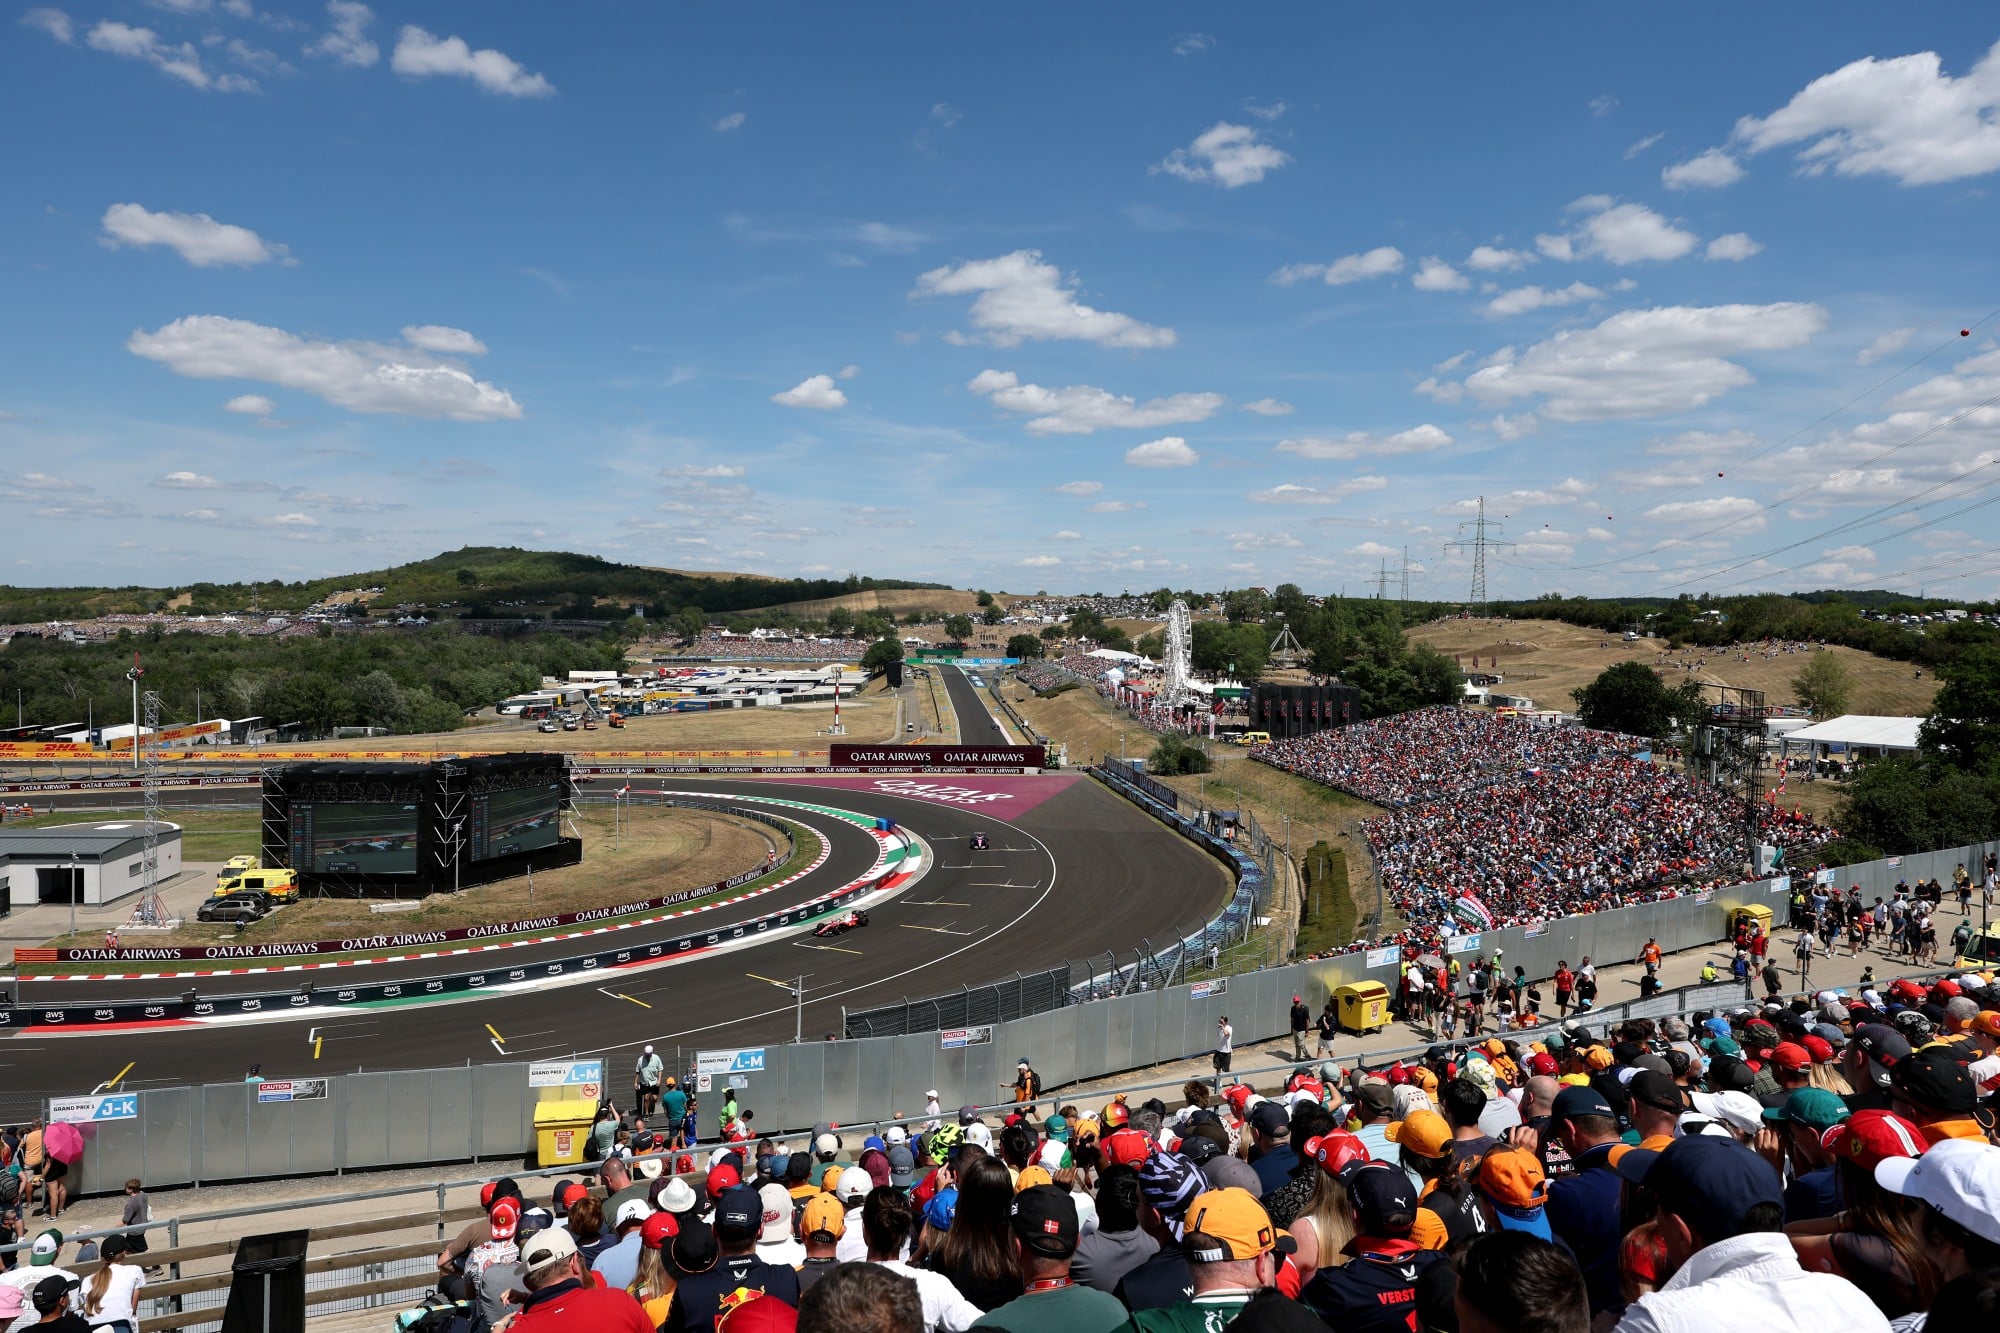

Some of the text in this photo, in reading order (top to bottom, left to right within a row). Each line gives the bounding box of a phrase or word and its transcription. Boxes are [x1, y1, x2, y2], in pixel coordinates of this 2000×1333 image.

[164, 730, 182, 740] DHL
[195, 724, 214, 734] DHL
[851, 752, 931, 761] QATAR AIRWAYS
[944, 753, 1024, 762] QATAR AIRWAYS
[874, 780, 1014, 800] QATAR
[726, 869, 762, 888] QATAR AIRWAYS
[662, 884, 717, 905] QATAR AIRWAYS
[576, 900, 649, 922] QATAR AIRWAYS
[1458, 909, 1478, 922] SINCE
[468, 916, 558, 938] QATAR AIRWAYS
[342, 931, 446, 950] QATAR AIRWAYS
[1467, 938, 1480, 948] A-B
[70, 949, 181, 960] QATAR AIRWAYS
[206, 943, 318, 958] QATAR AIRWAYS
[737, 1056, 762, 1068] L-M
[571, 1069, 598, 1080] L-M
[102, 1101, 135, 1116] J-K
[1549, 1164, 1569, 1173] Mobil
[1472, 1205, 1486, 1232] 4
[1377, 1288, 1415, 1305] VERST
